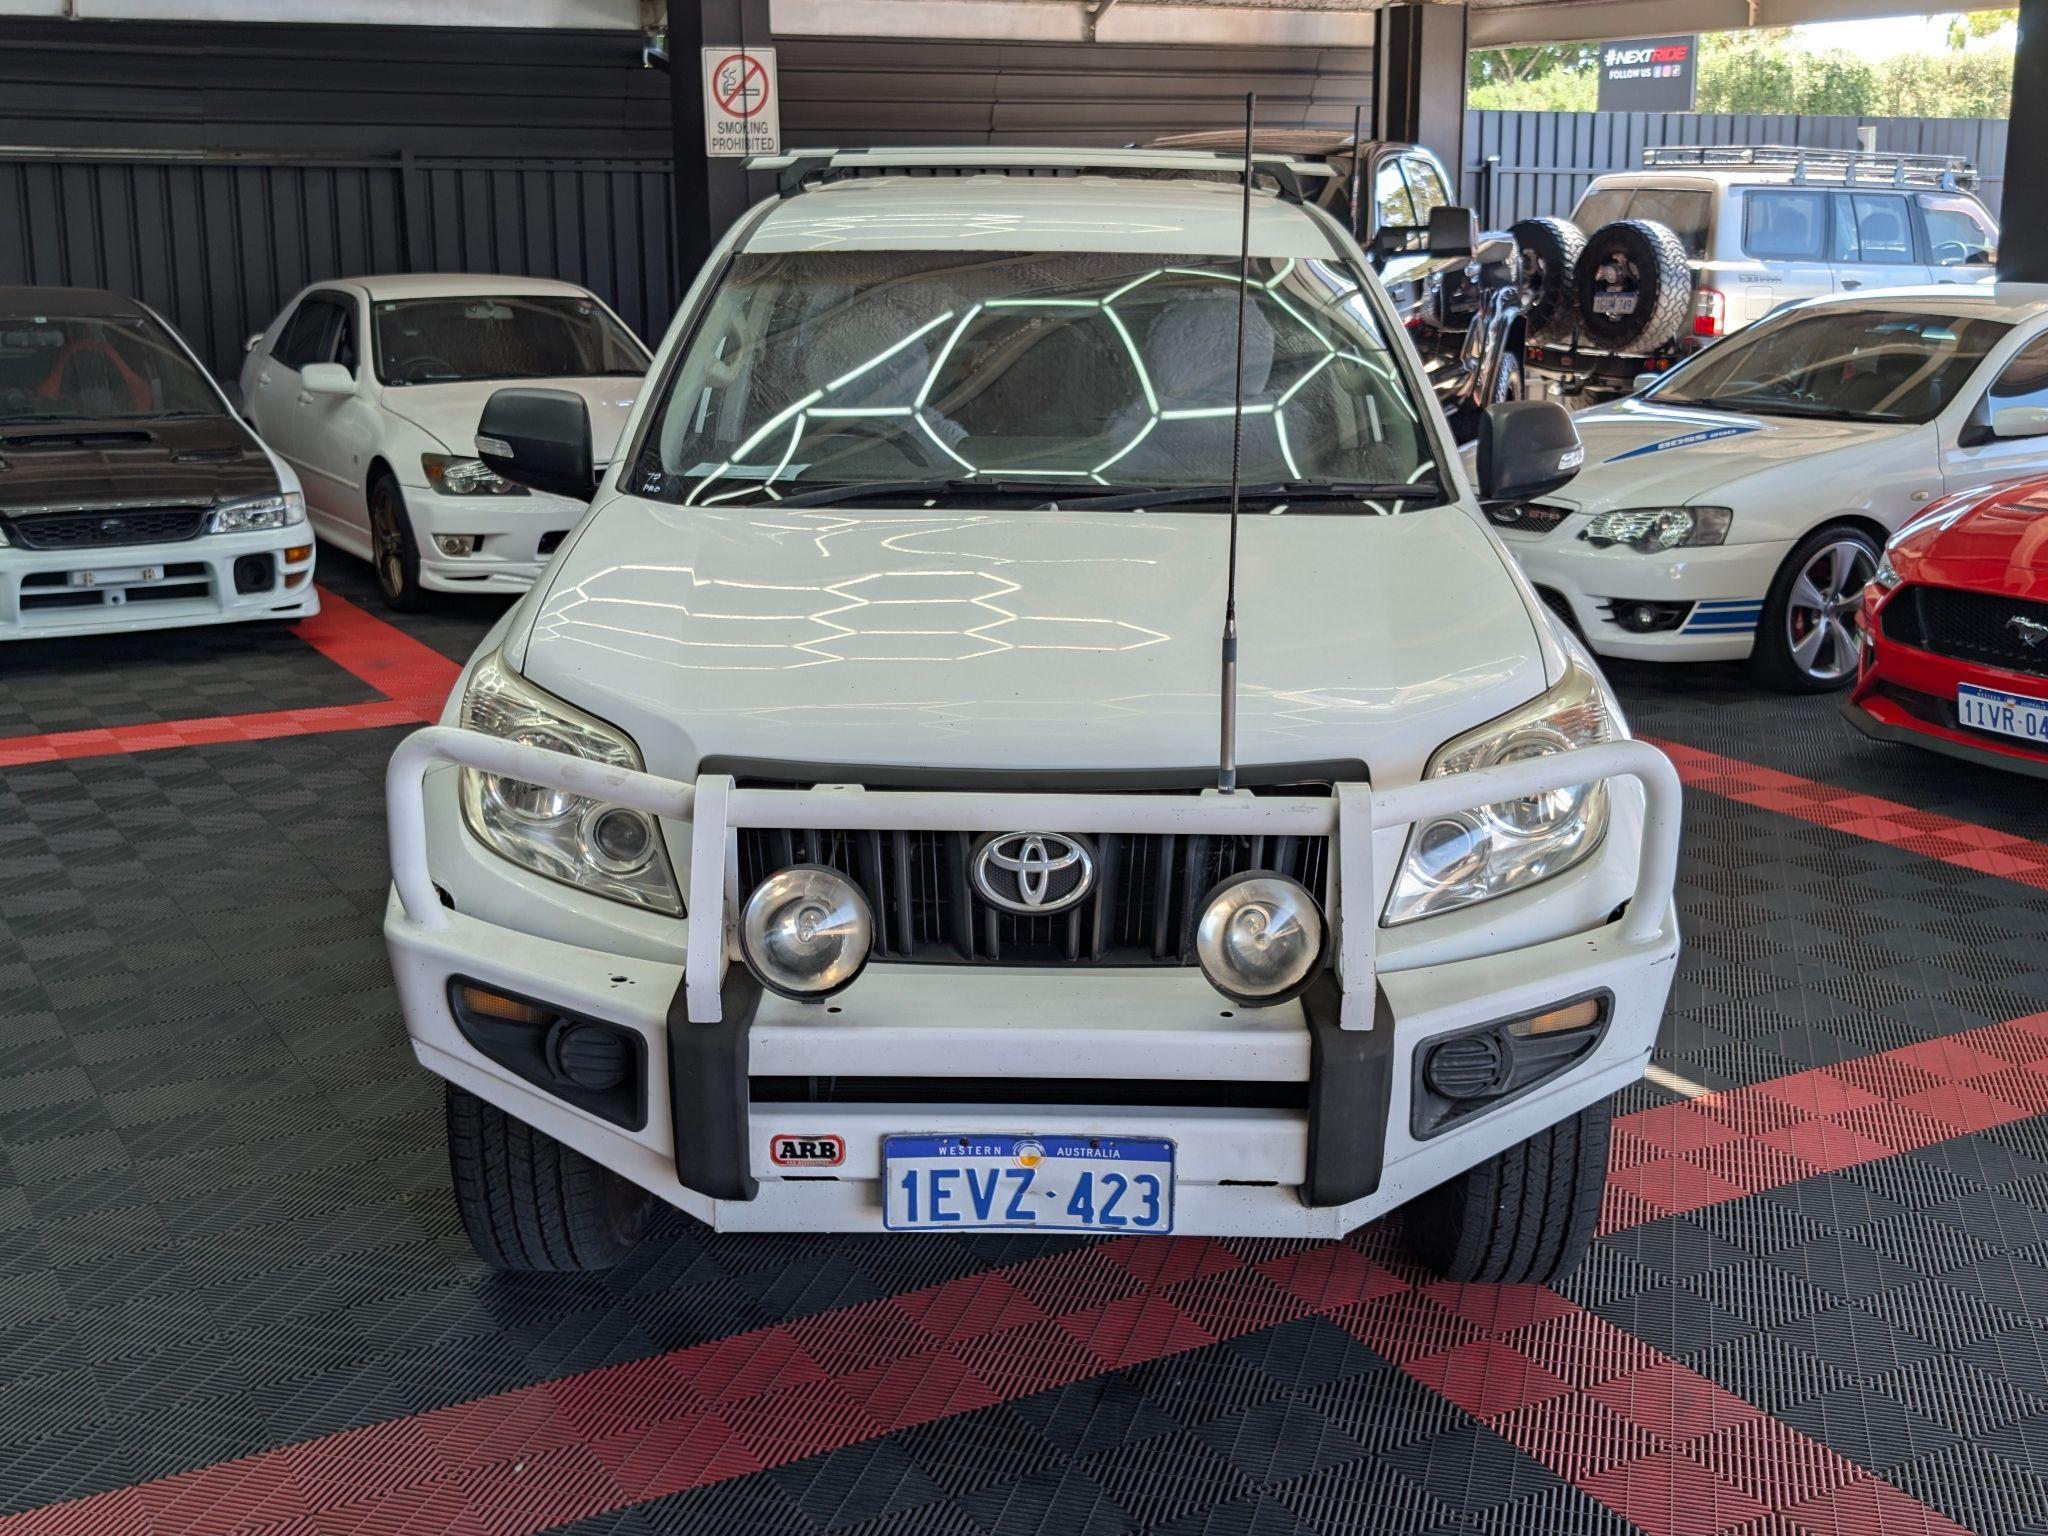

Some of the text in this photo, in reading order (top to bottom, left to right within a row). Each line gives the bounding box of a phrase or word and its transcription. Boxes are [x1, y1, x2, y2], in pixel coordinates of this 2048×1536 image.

[1603, 45, 1689, 67] #NEXTRIDE
[1609, 67, 1652, 80] FOLLOW US
[718, 121, 769, 135] SMOKING
[1657, 433, 1707, 450] BOSS
[1965, 699, 2015, 732] 1IVR
[780, 1140, 836, 1159] ARB
[938, 1145, 1121, 1159] WESTERN AUSTRALIA
